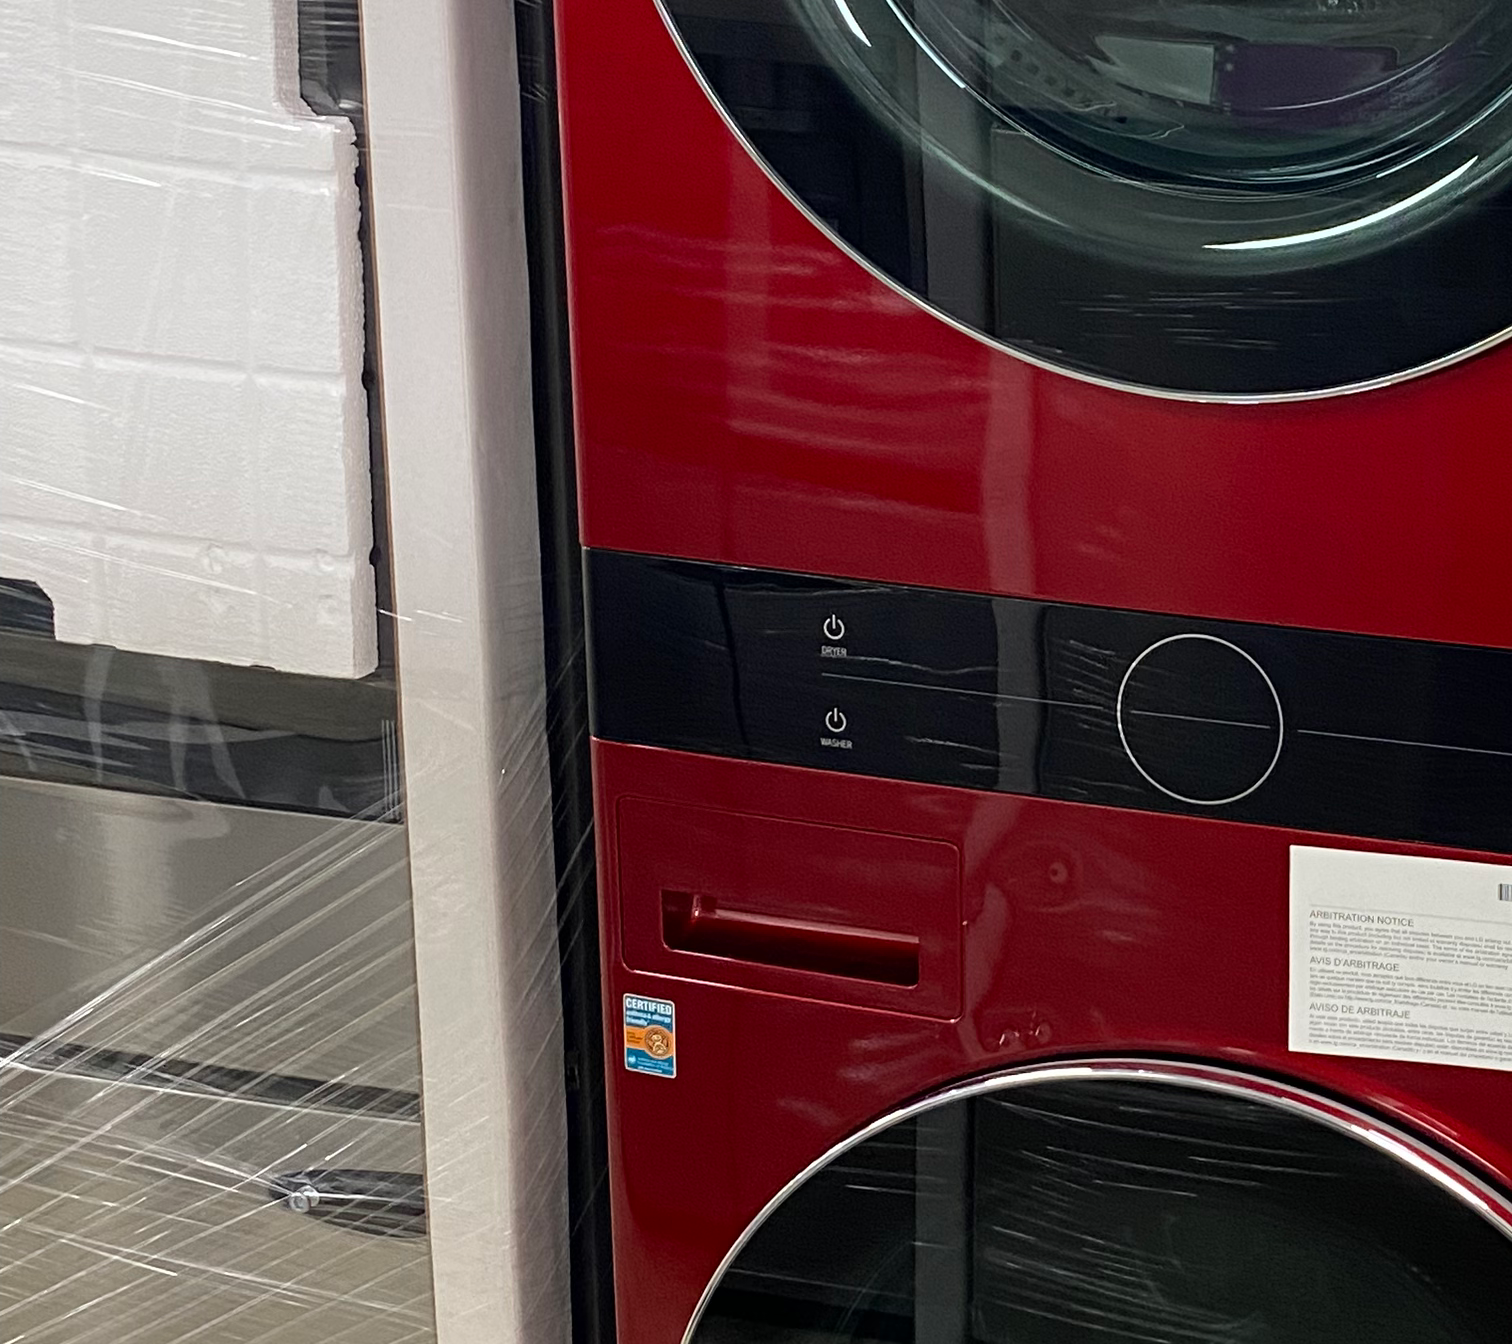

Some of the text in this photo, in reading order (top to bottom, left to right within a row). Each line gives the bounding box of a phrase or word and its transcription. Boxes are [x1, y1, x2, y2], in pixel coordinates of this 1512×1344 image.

[821, 645, 847, 657] DRYER
[820, 737, 853, 749] WASHER
[1309, 910, 1415, 928] ARBITRATION NOTICE
[1309, 956, 1400, 973] AVIS D'ARBITRAGE
[626, 998, 672, 1015] CERTIFIED
[1309, 1003, 1411, 1020] AVISO DE ARBITRAJE
